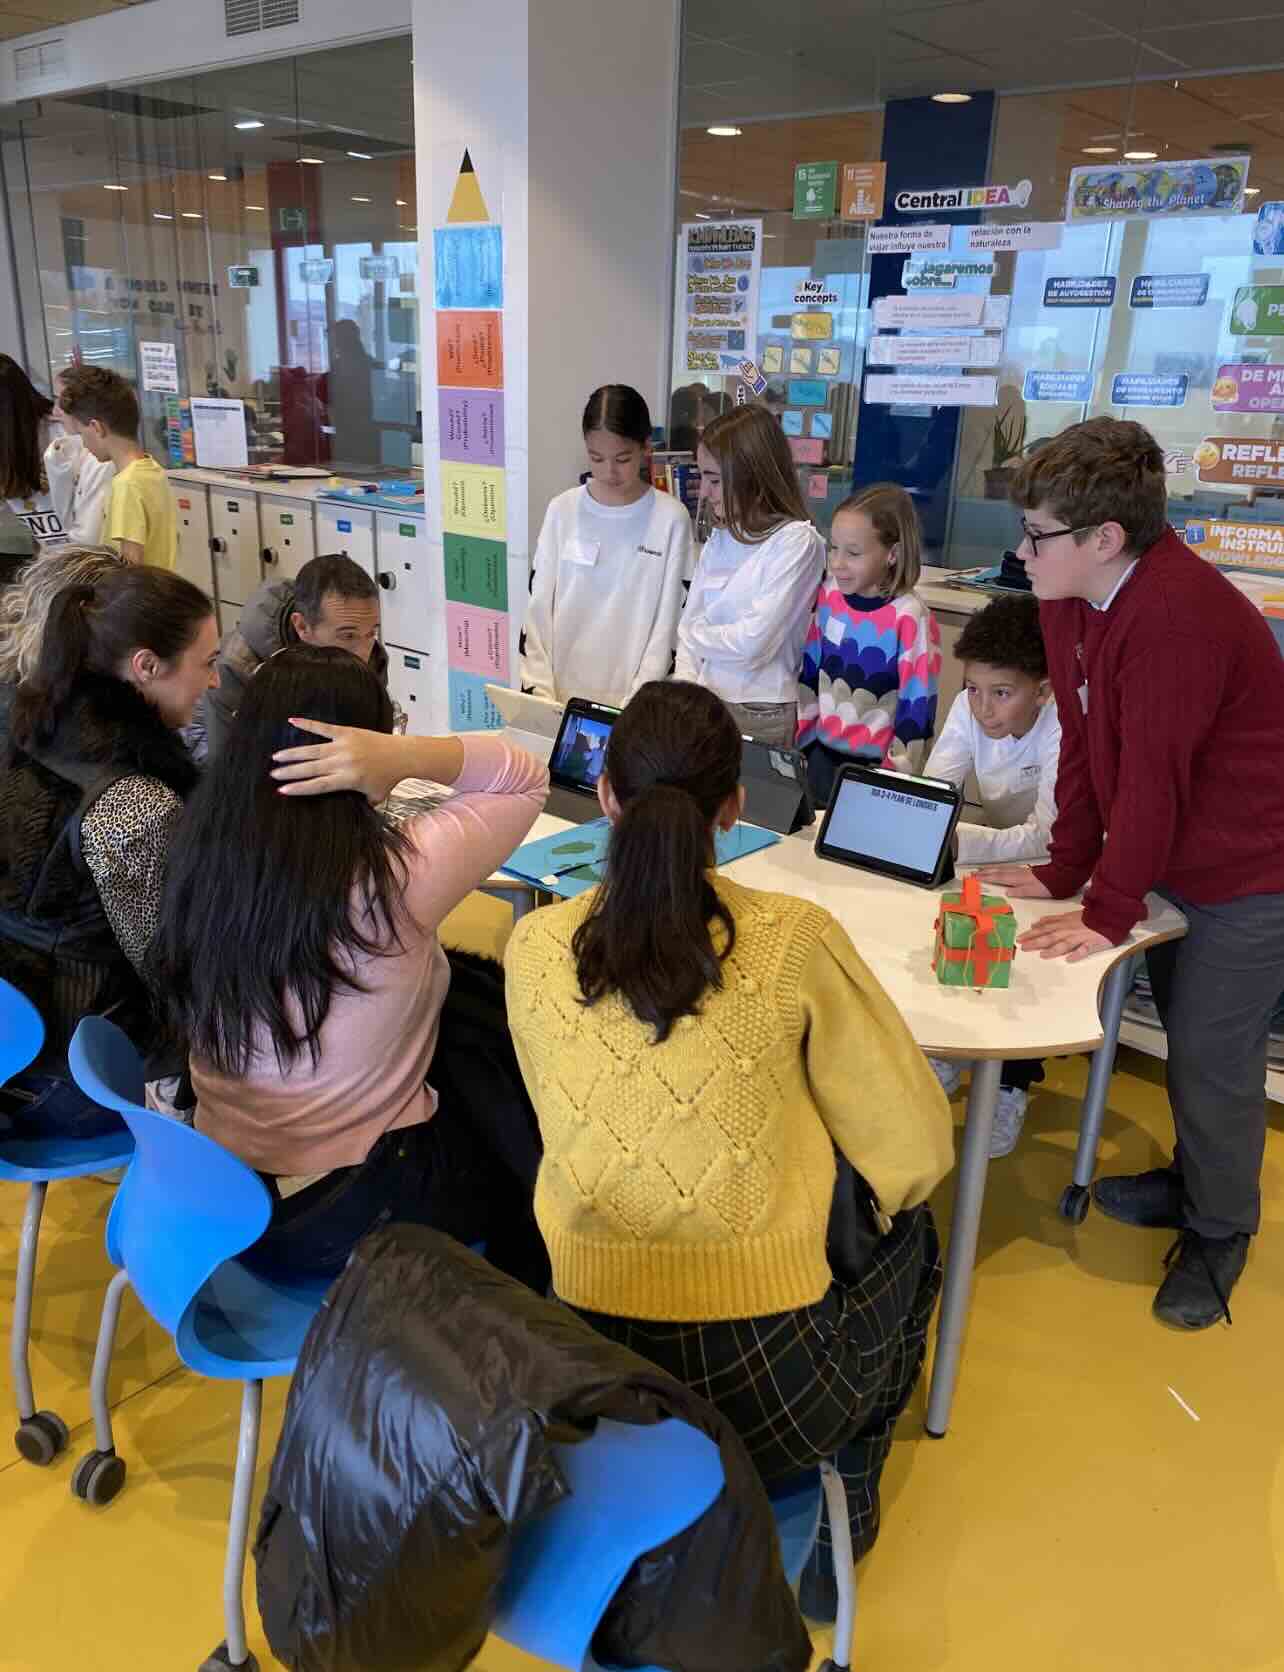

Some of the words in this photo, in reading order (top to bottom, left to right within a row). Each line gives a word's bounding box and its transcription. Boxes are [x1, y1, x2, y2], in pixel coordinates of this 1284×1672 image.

[897, 191, 963, 208] Central
[967, 188, 1010, 206] IDEA
[1103, 197, 1143, 209] Sharing
[1147, 196, 1163, 207] the
[1168, 193, 1205, 205] Planet
[900, 231, 922, 239] forma
[1006, 227, 1022, 235] con
[890, 241, 916, 251] influye
[970, 240, 1012, 249] naturaleza
[804, 281, 823, 294] Key
[1053, 280, 1109, 288] HABILIDADES
[794, 293, 838, 305] concepts
[1241, 370, 1266, 382] DE
